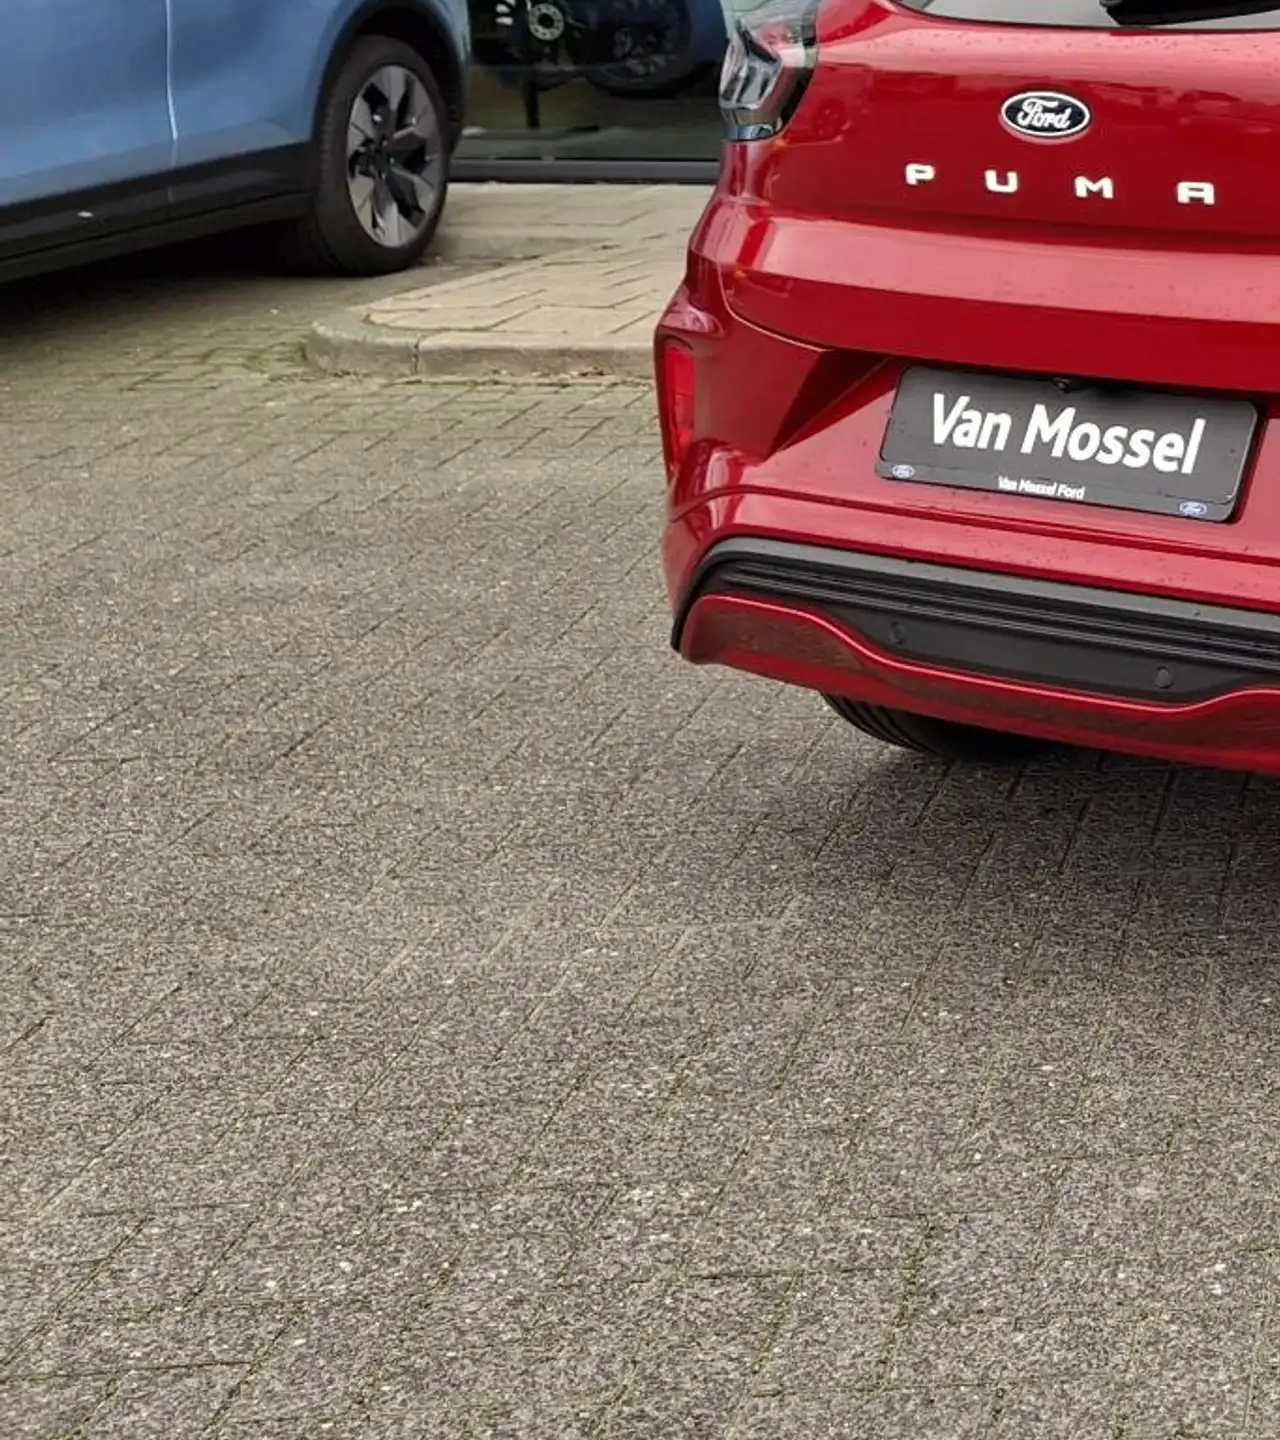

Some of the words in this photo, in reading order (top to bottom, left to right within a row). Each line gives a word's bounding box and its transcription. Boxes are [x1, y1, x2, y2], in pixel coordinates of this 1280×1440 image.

[1016, 98, 1072, 130] Ford
[905, 163, 1215, 205] PUMA
[933, 393, 1011, 451] Van
[1020, 403, 1207, 474] Mossel
[998, 475, 1018, 491] Van
[1019, 478, 1057, 497] Mossel
[1057, 482, 1085, 500] Ford
